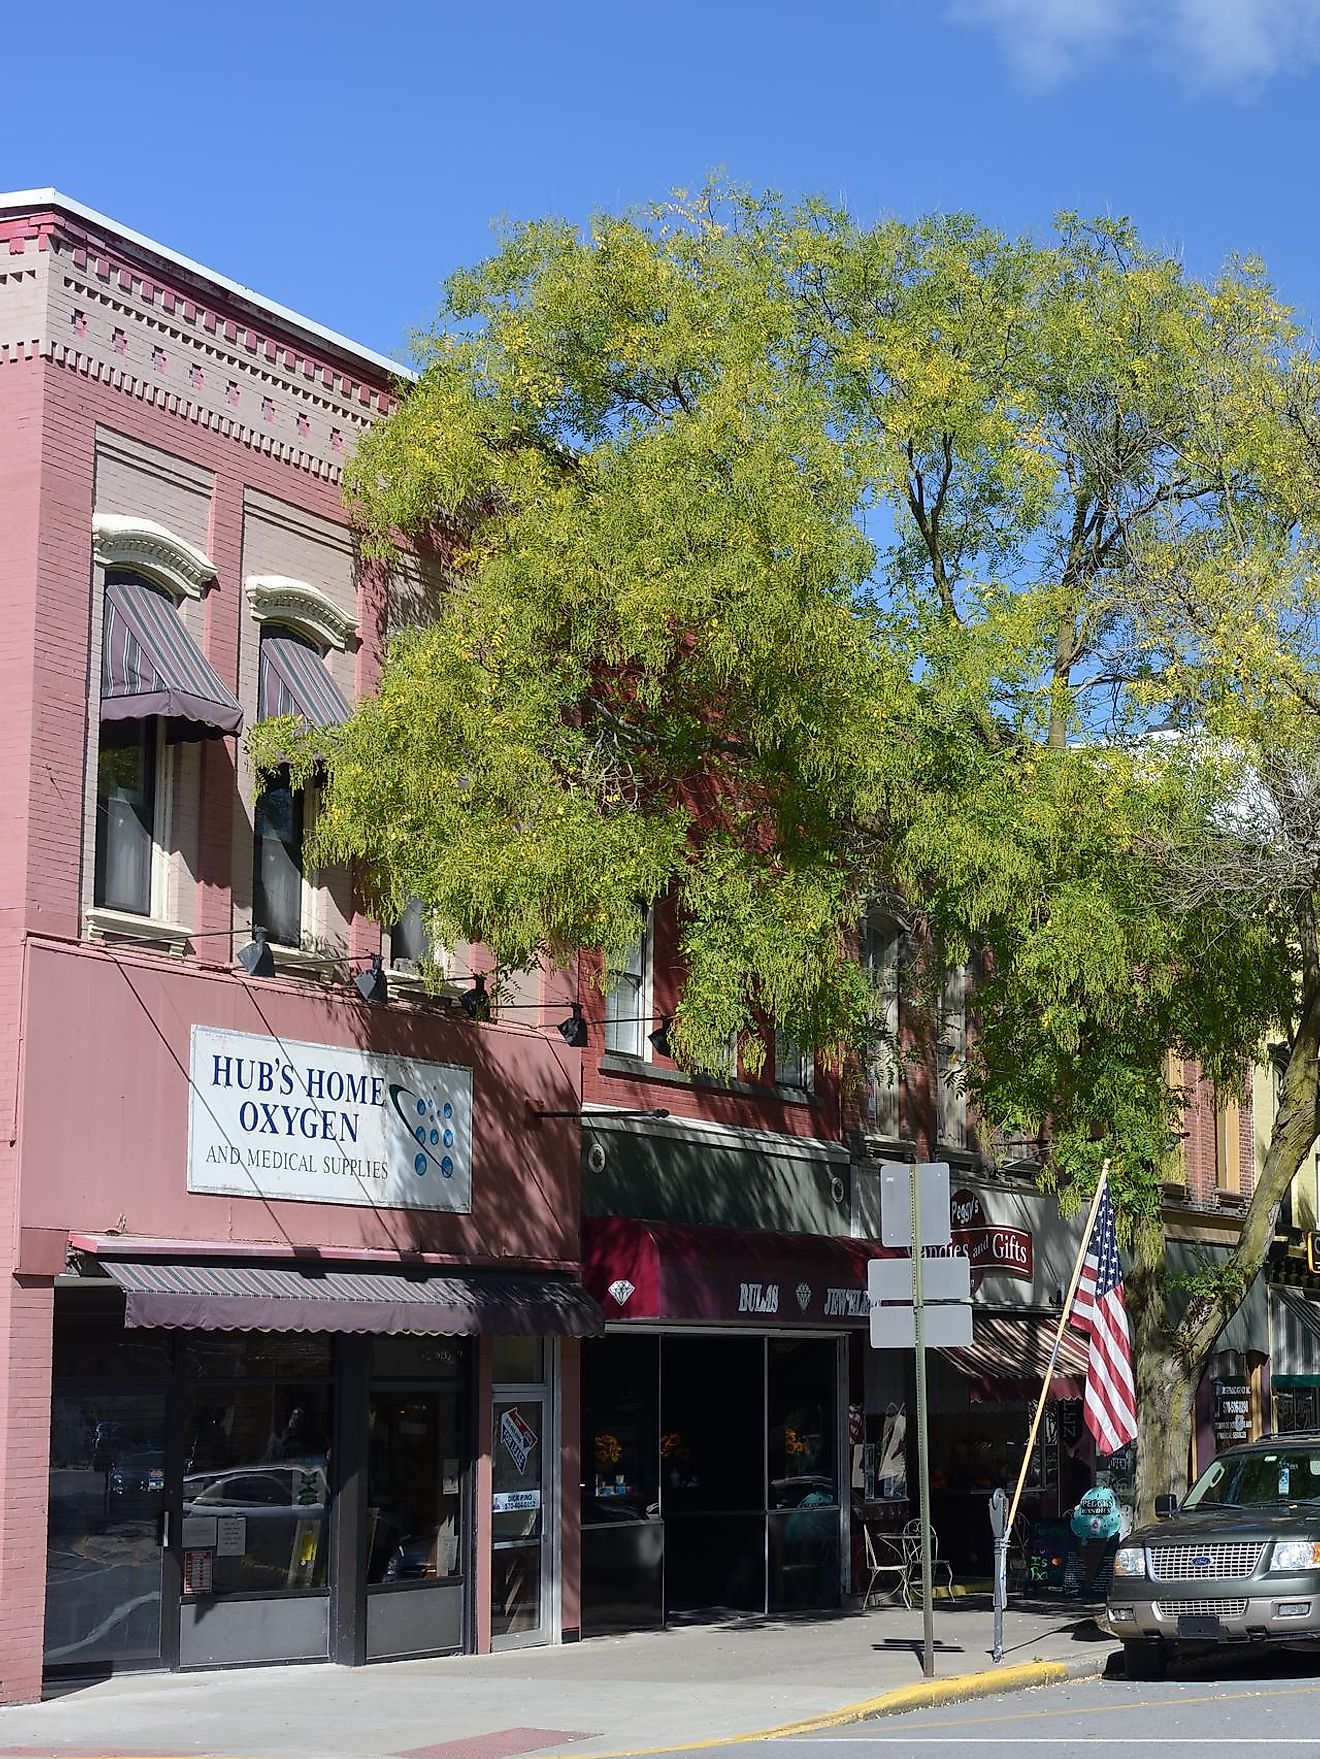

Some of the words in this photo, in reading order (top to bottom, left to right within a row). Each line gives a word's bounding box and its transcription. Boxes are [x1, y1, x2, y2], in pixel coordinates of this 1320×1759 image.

[211, 1054, 295, 1096] HUB'S
[305, 1067, 386, 1108] HOME
[239, 1100, 360, 1143] OXYGEN
[206, 1145, 241, 1165] AND
[247, 1148, 317, 1173] MEDICAL
[323, 1156, 389, 1180] SUPPLIES
[950, 1195, 979, 1225] Peggy's
[972, 1235, 990, 1259] and
[992, 1232, 1028, 1264] Gifts
